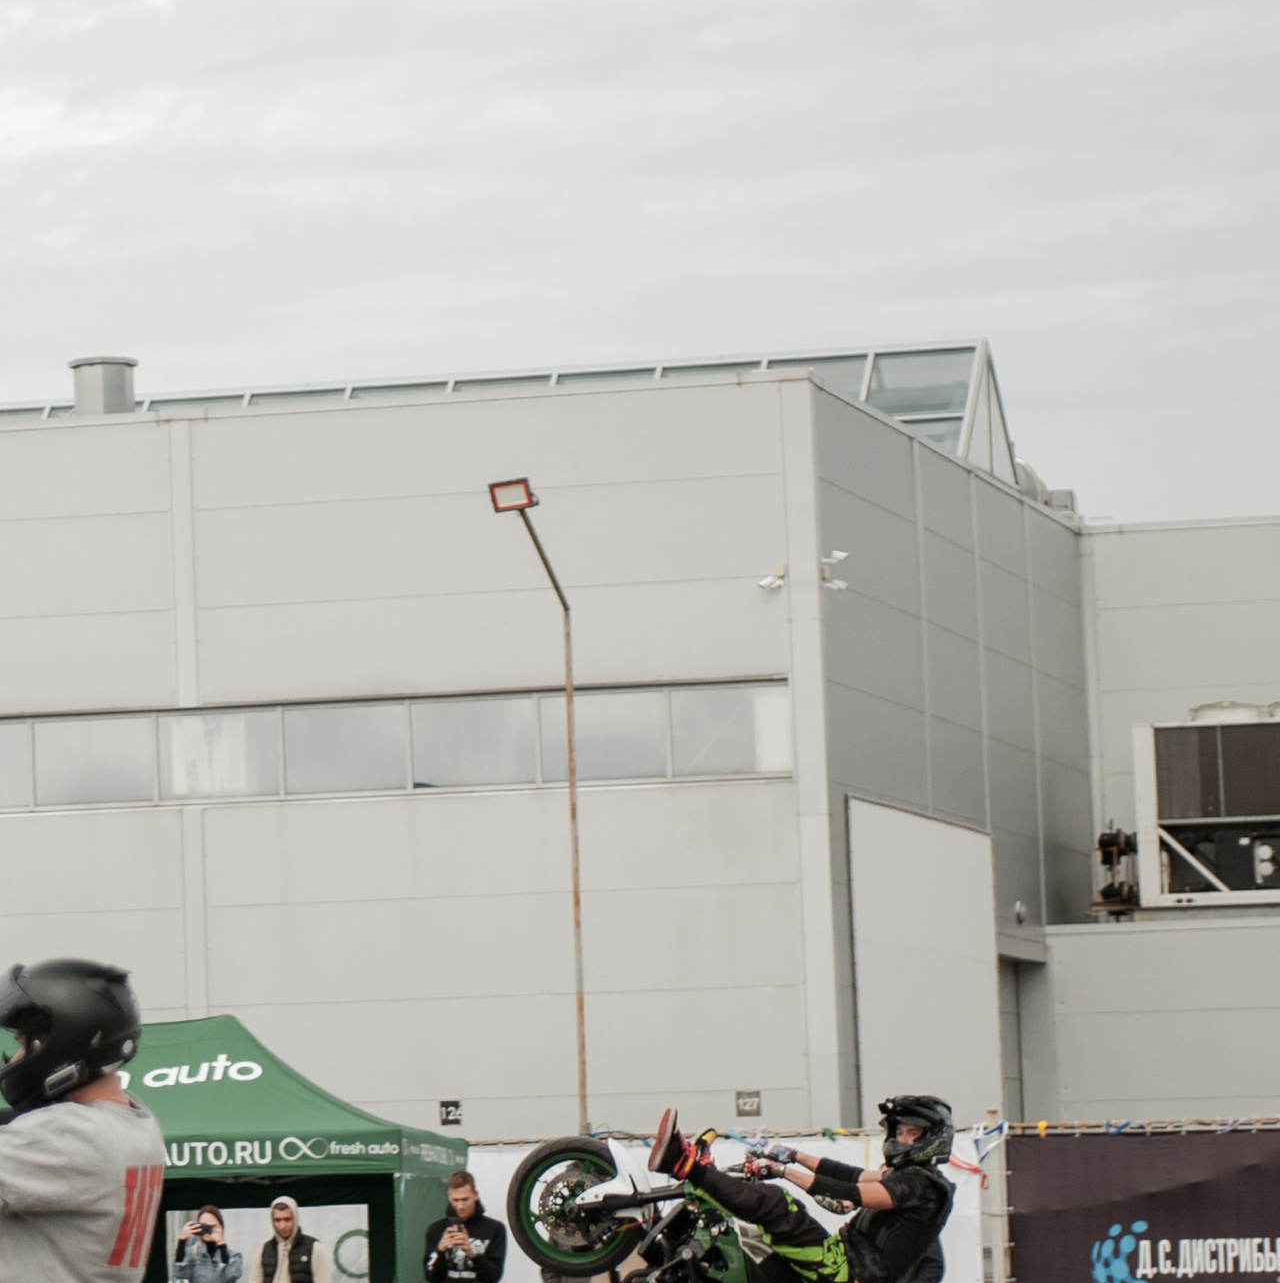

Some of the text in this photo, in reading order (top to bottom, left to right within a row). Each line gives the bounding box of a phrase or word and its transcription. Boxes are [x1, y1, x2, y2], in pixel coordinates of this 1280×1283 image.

[142, 1053, 263, 1088] auto
[440, 1106, 464, 1121] 126
[737, 1097, 760, 1110] 127
[165, 1139, 272, 1167] UTO.RU
[328, 1140, 366, 1156] fresh
[367, 1141, 400, 1156] auto
[1136, 1237, 1280, 1279] Д.С.ДИСТРИБЬ
